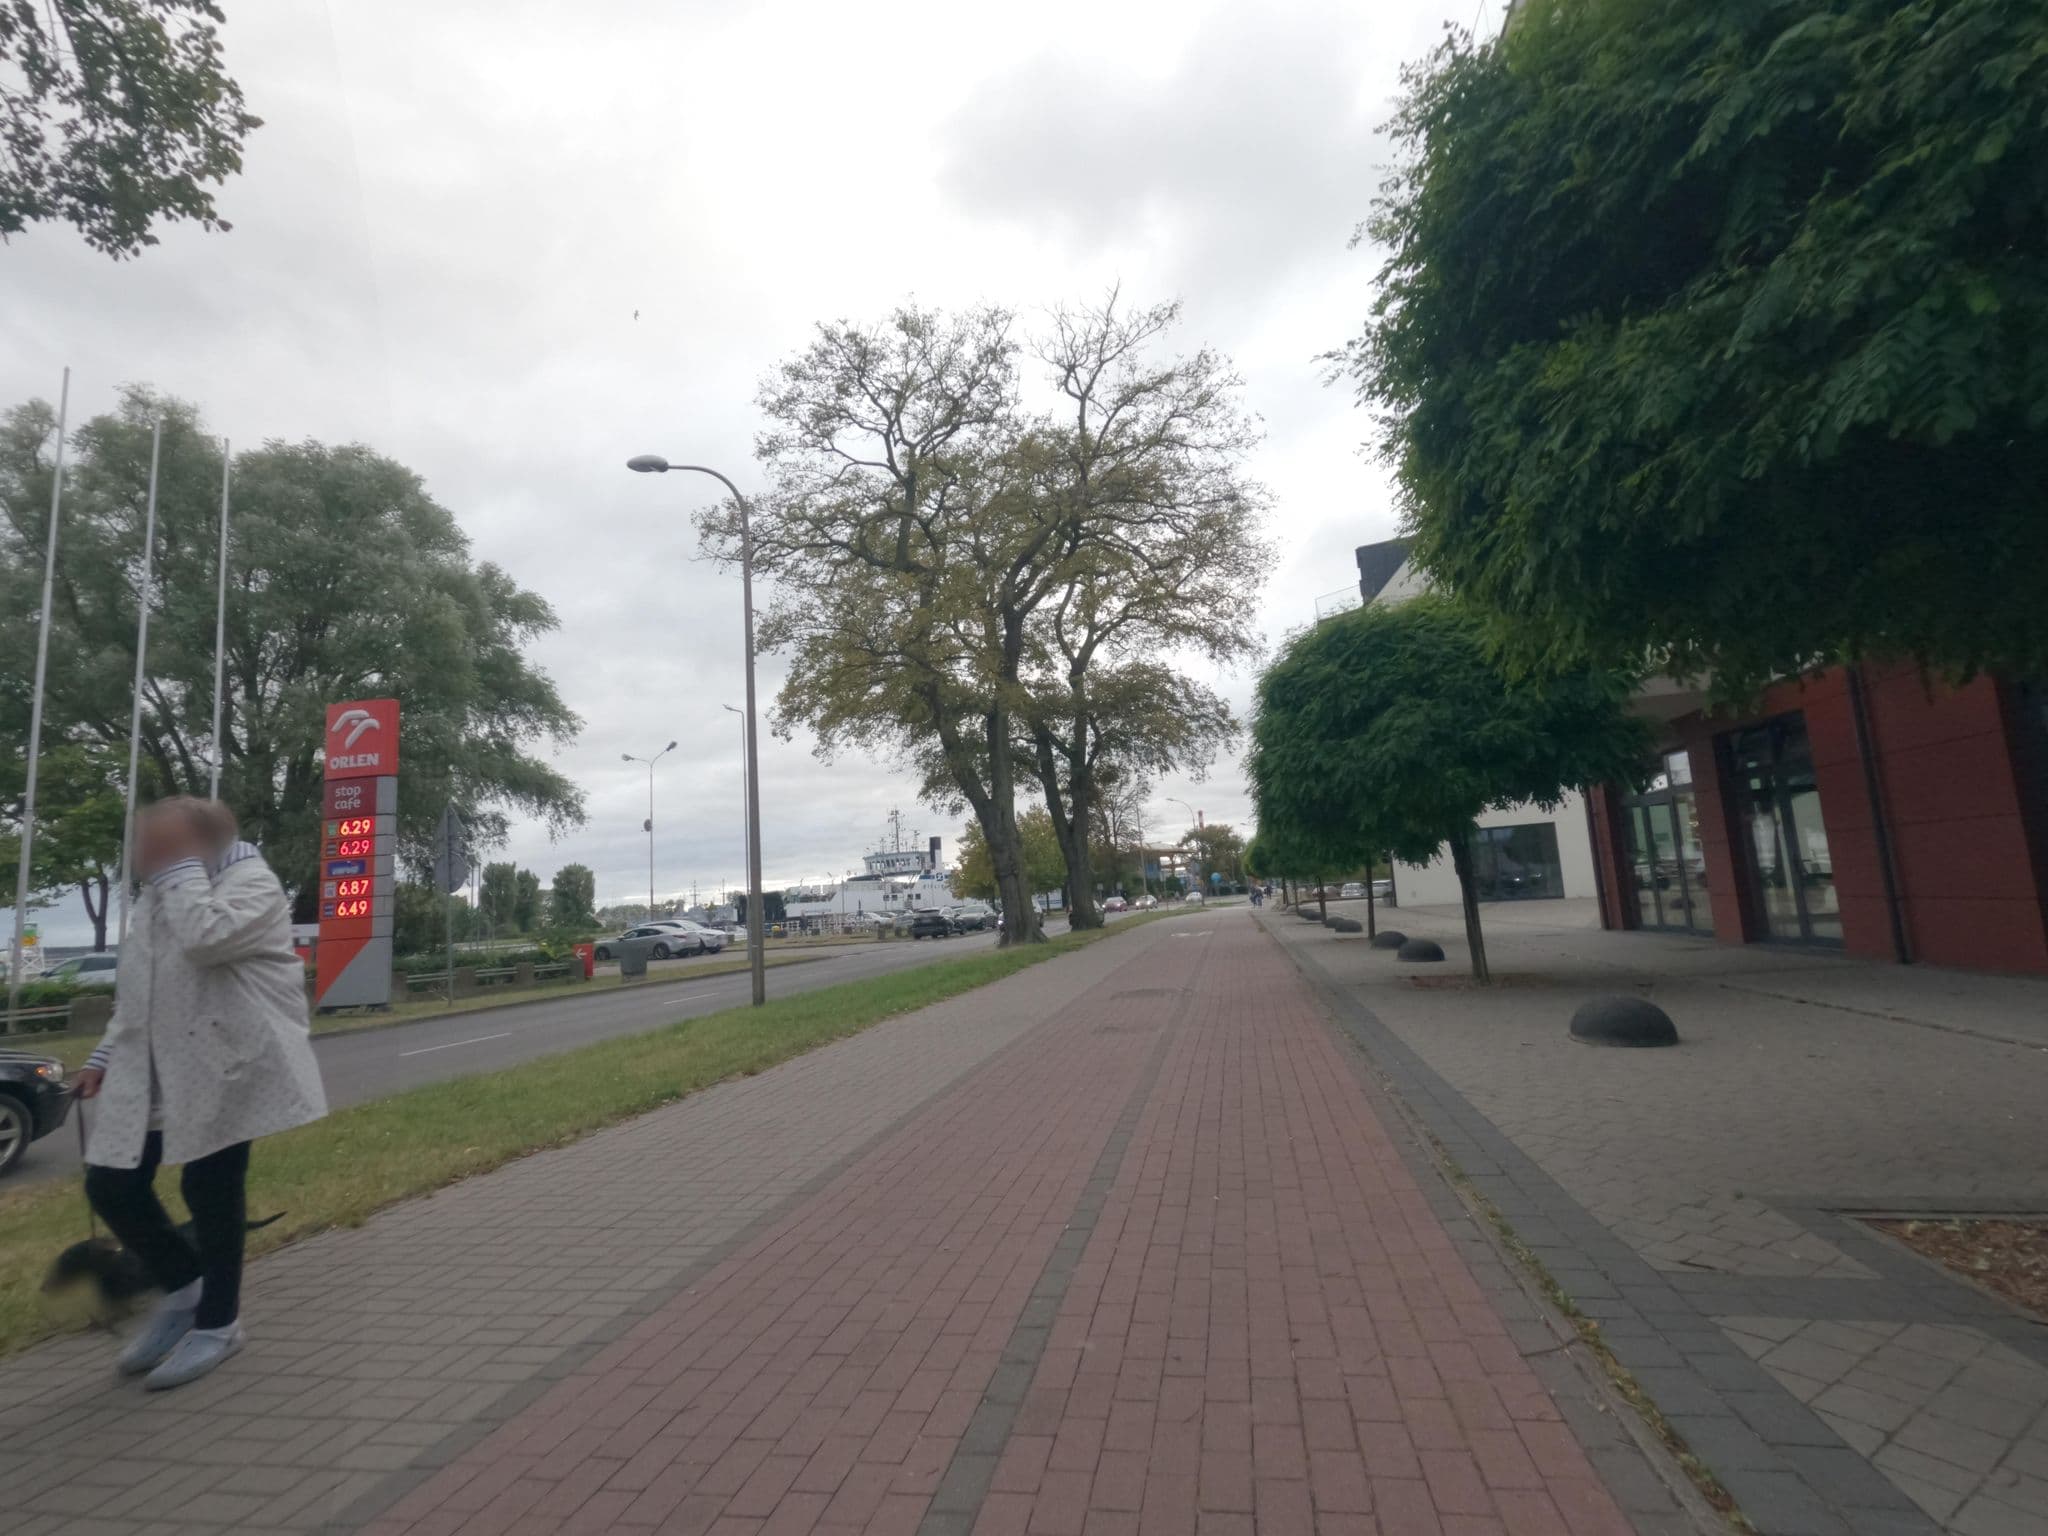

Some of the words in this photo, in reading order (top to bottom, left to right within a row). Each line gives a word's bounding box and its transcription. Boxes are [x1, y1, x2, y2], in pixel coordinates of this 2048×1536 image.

[330, 753, 379, 769] ORLEN
[335, 786, 361, 798] stop
[334, 798, 361, 810] cafe
[340, 820, 371, 836] 6.29
[340, 840, 370, 855] 6.29
[339, 880, 369, 896] 6.87
[338, 900, 368, 916] 6.49
